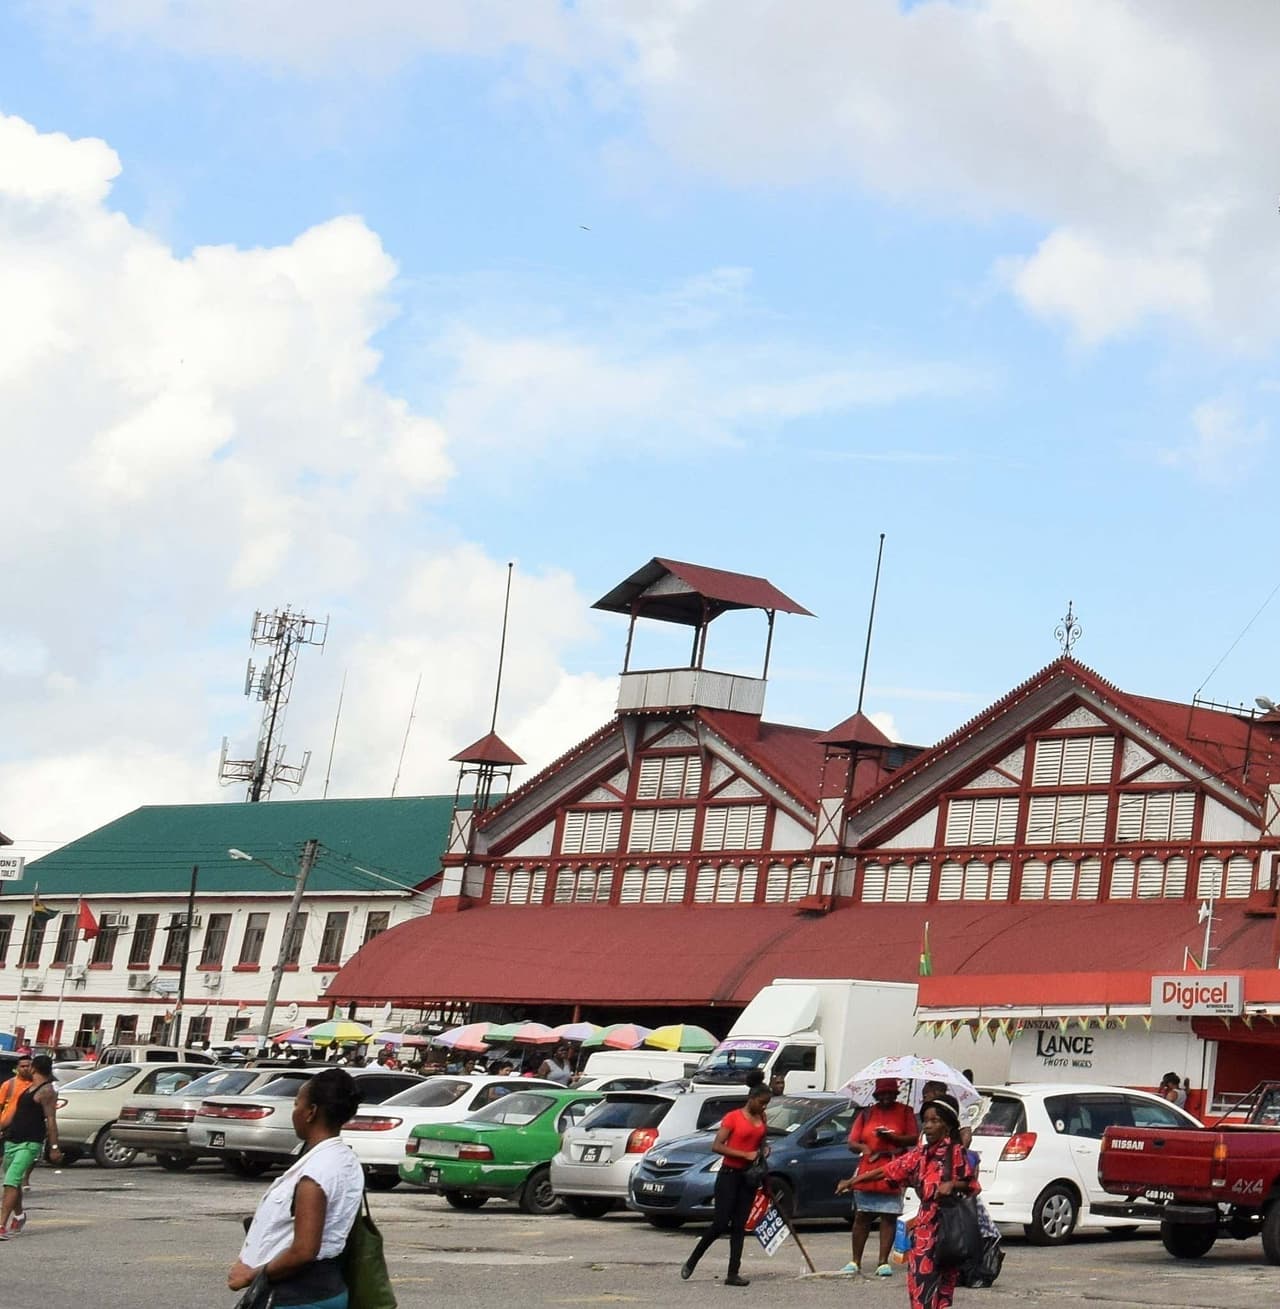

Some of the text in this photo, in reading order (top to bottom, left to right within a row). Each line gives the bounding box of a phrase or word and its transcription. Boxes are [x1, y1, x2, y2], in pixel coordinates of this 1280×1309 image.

[1162, 981, 1227, 1009] Digicel
[1111, 1139, 1145, 1151] NISSAN
[759, 1216, 784, 1245] Here
